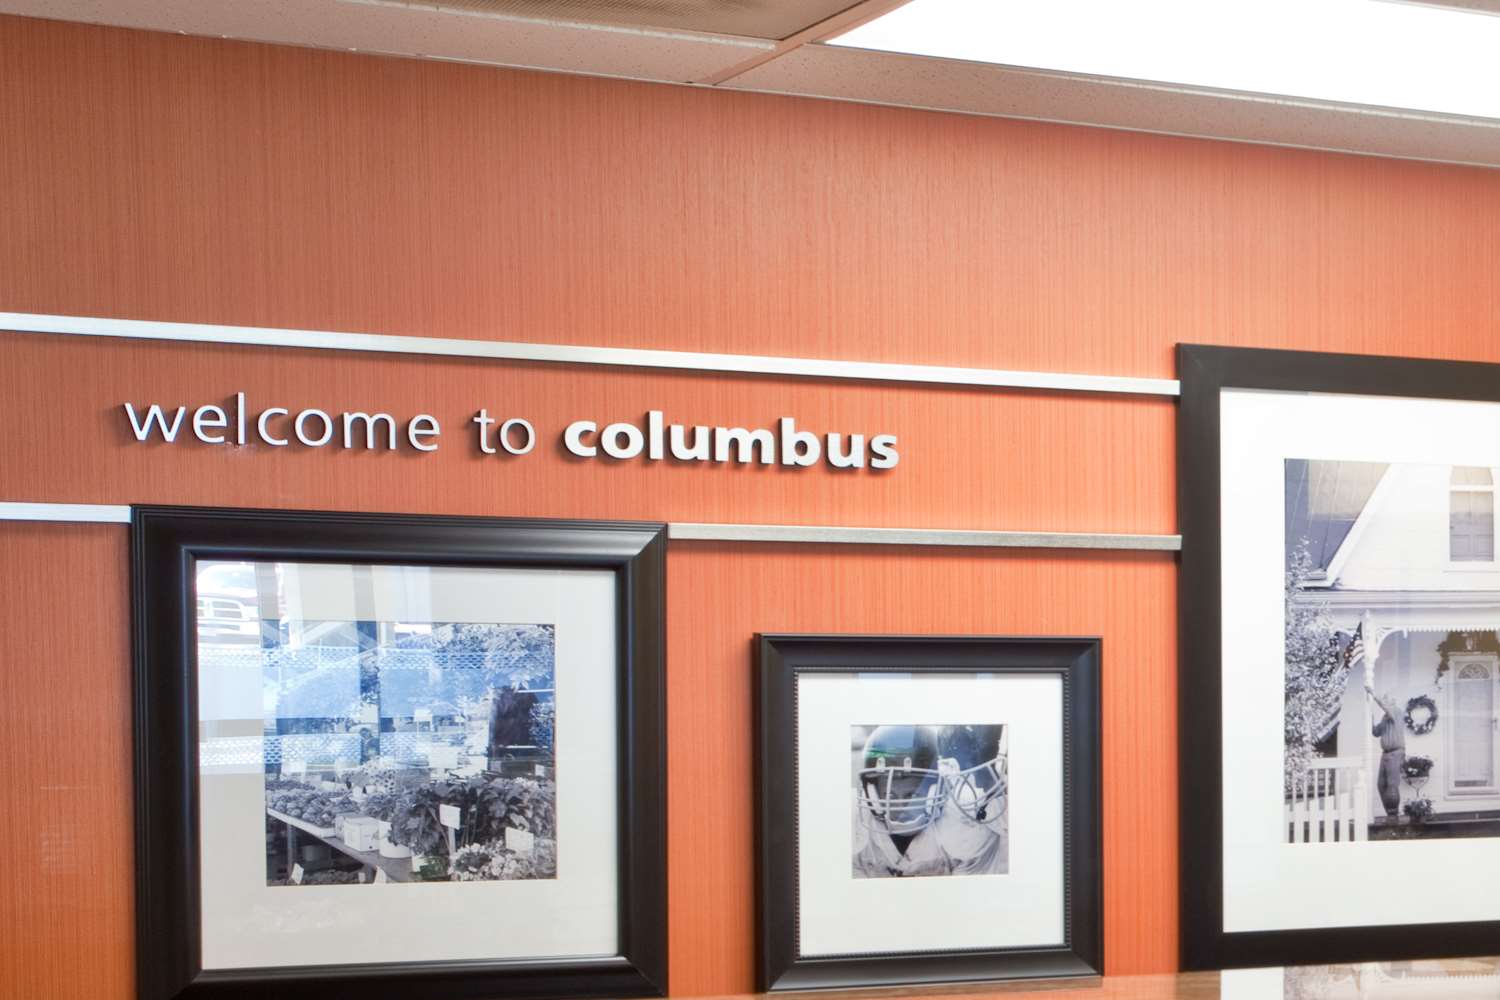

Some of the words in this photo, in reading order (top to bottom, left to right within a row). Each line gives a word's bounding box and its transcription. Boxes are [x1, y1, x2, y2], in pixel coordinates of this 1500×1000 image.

[124, 391, 441, 451] welcome
[473, 408, 536, 455] to
[563, 410, 899, 469] columbus
